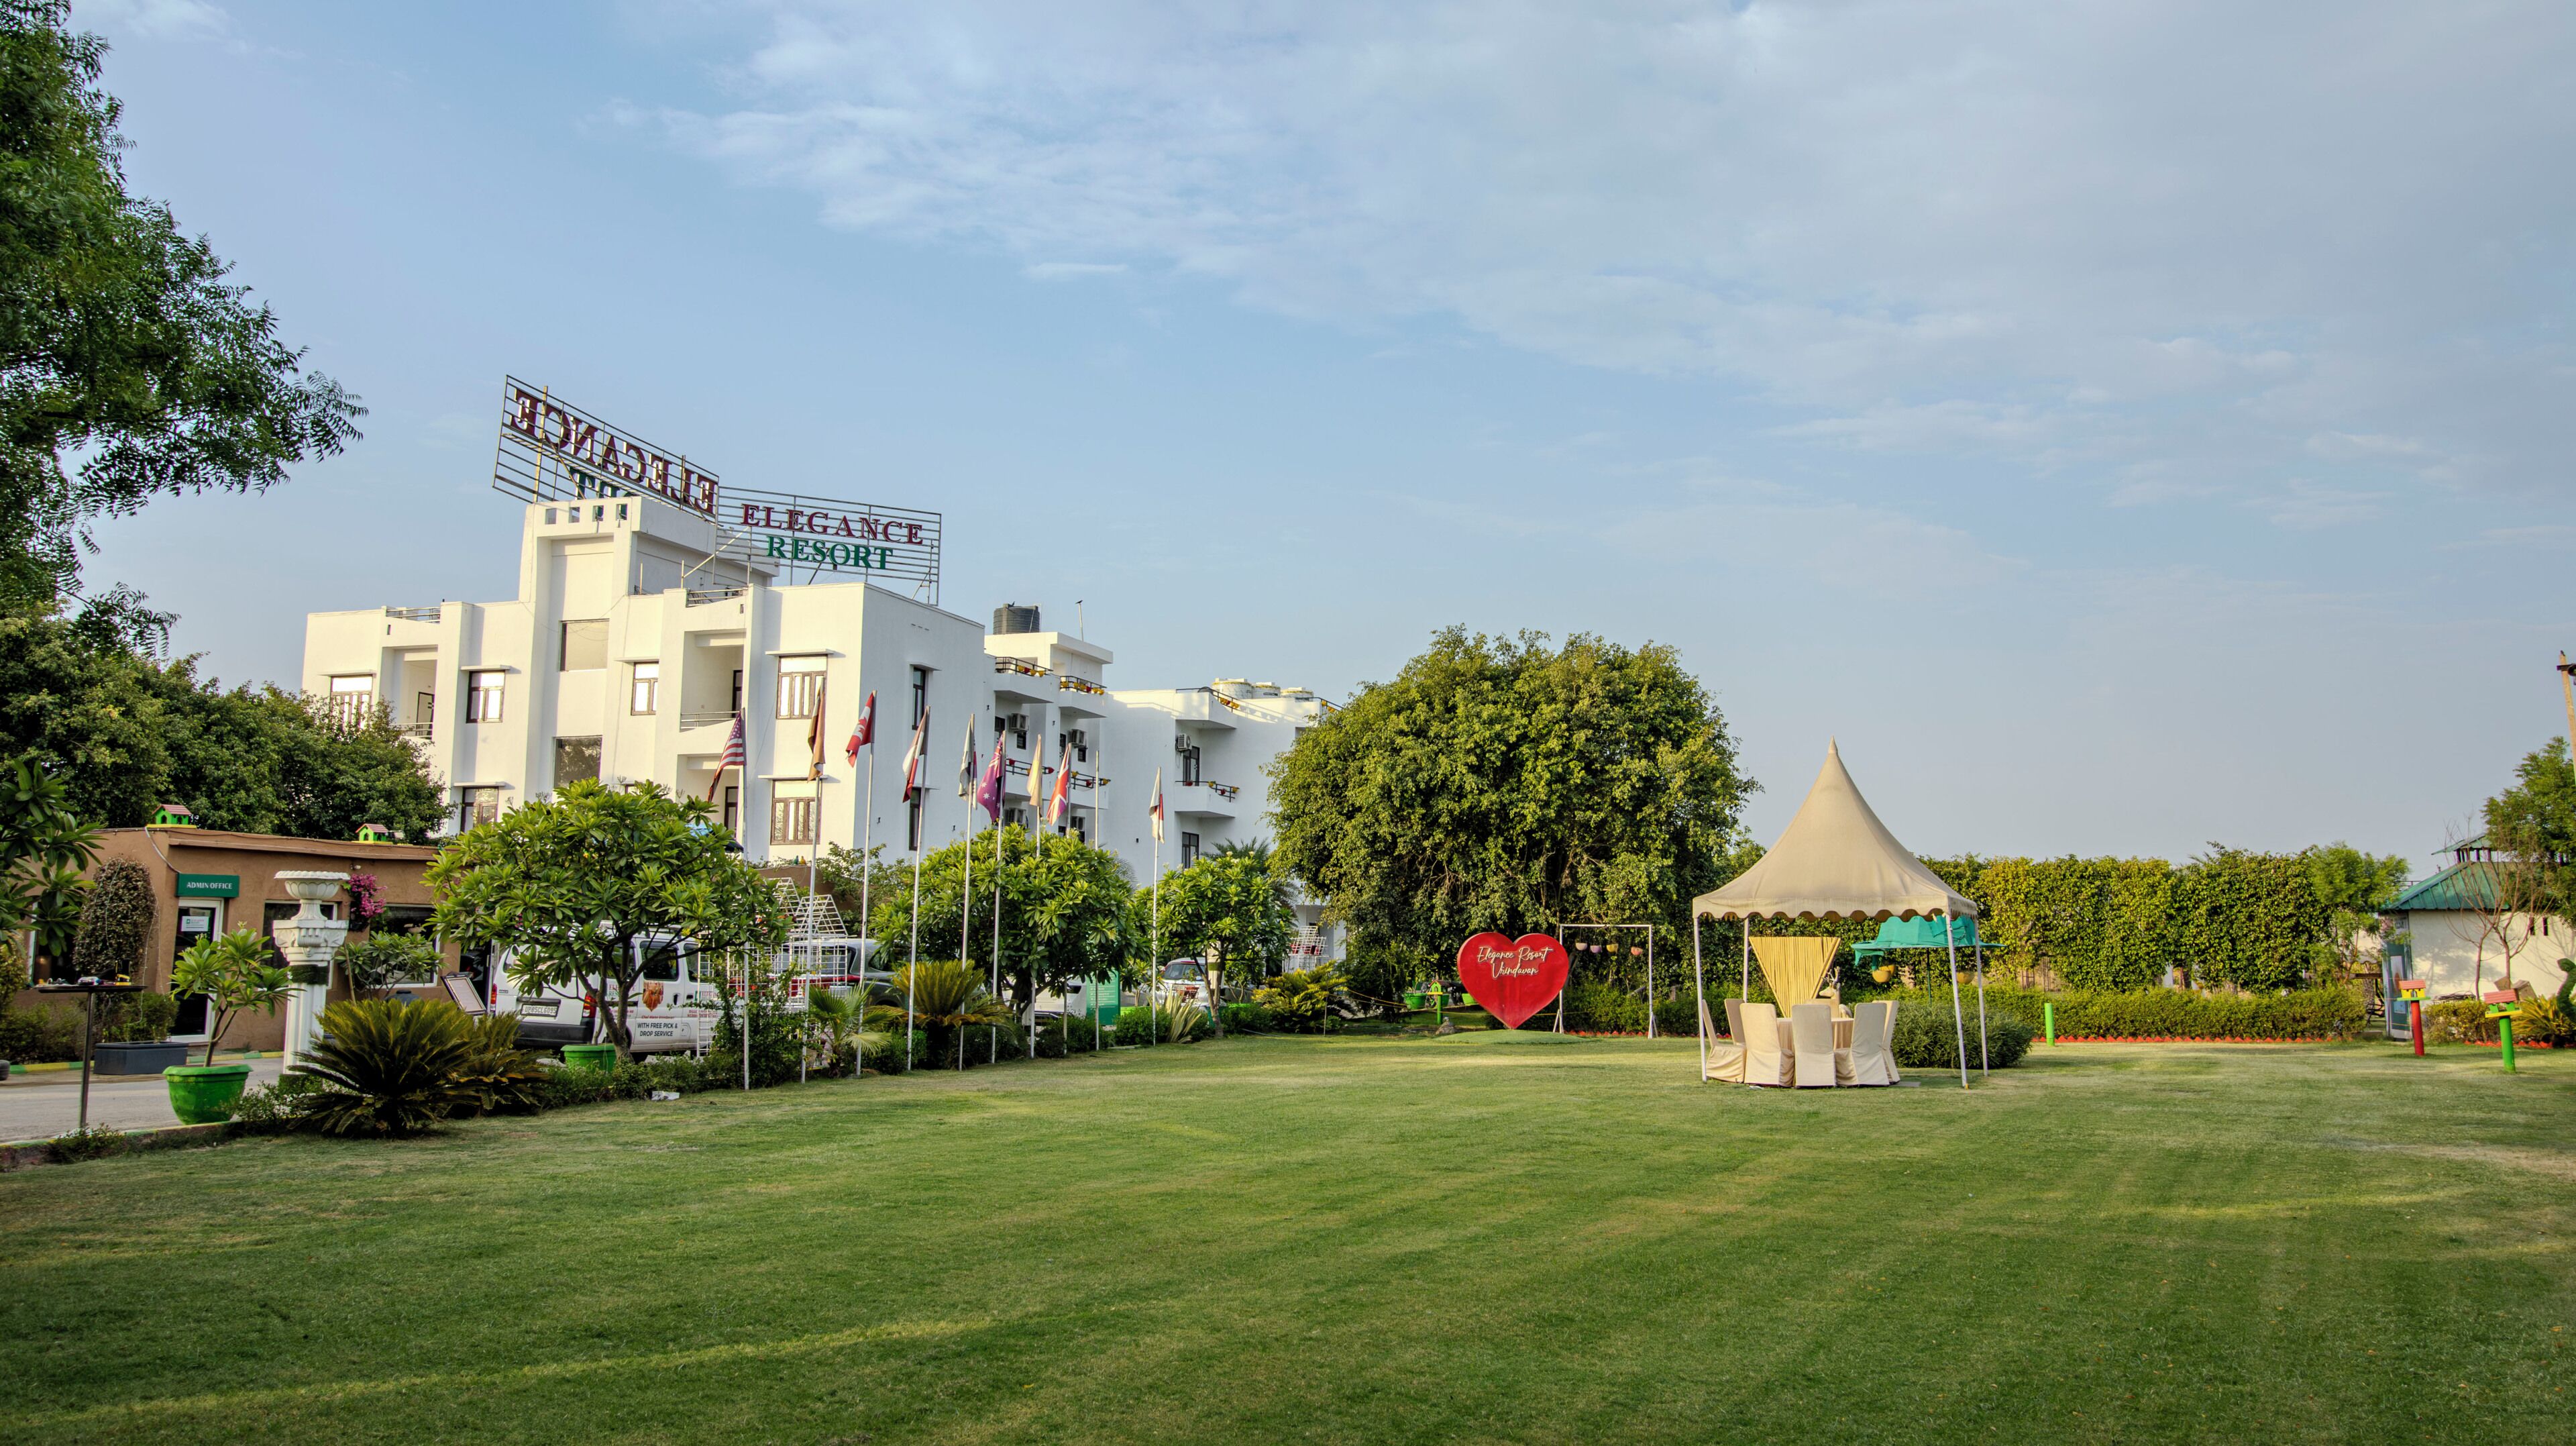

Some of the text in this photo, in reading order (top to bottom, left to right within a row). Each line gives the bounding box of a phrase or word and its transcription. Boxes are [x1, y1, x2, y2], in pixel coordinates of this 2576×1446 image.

[740, 503, 923, 545] ELEGANCE
[766, 535, 893, 570] RESORT
[1477, 946, 1554, 963] Elegance Resort
[1491, 962, 1538, 978] Vrindavan
